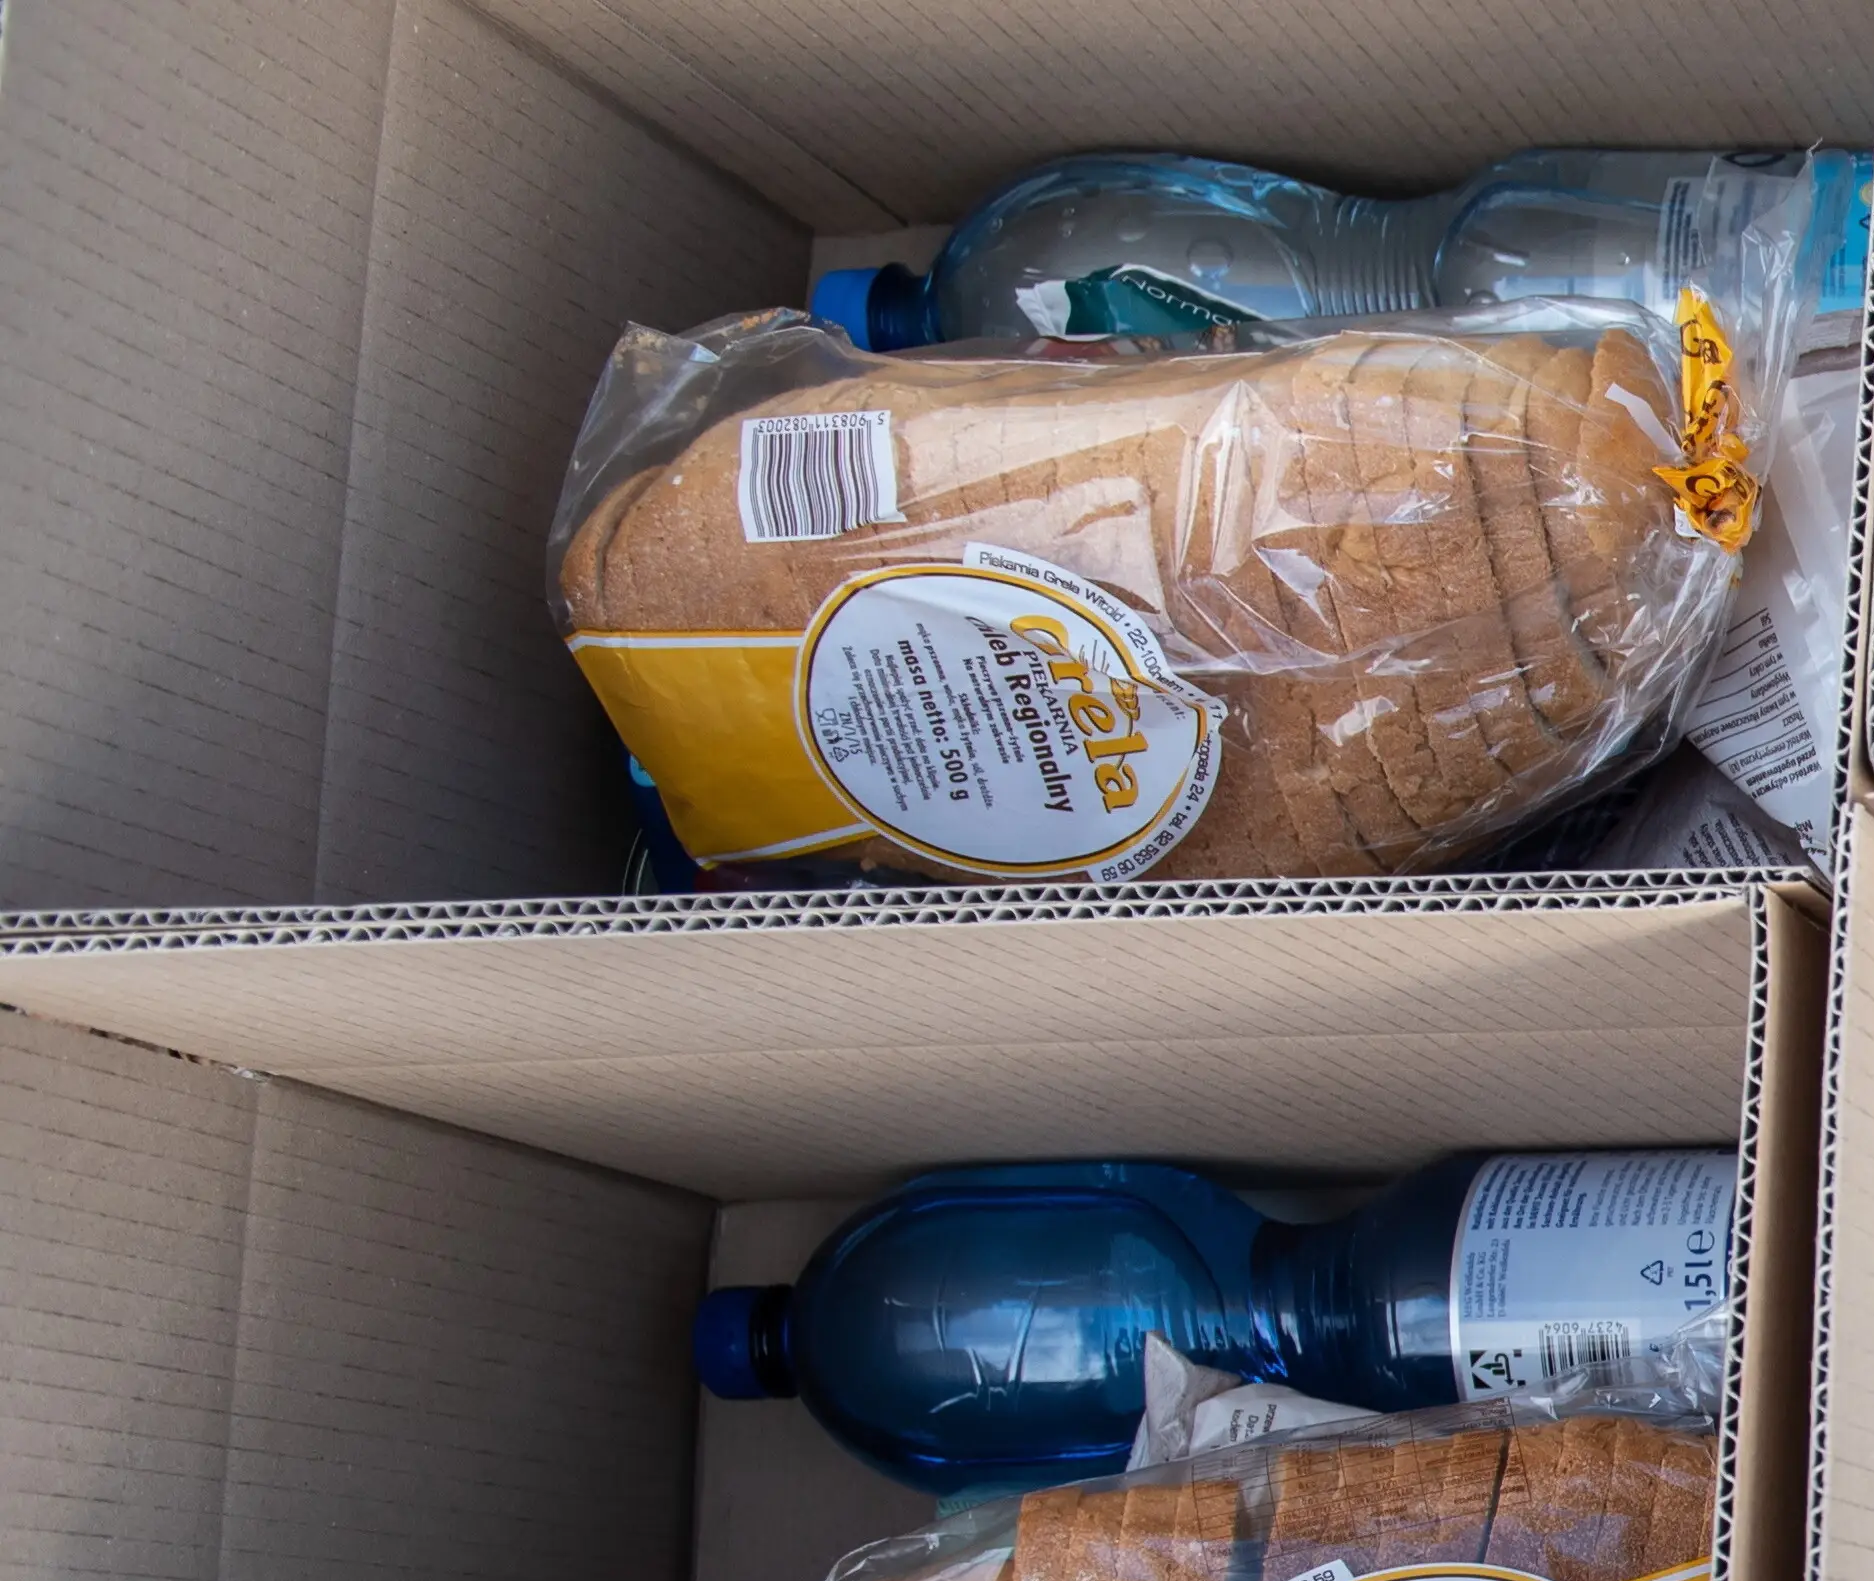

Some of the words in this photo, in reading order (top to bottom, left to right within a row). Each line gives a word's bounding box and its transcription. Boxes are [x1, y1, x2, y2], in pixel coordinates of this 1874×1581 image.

[1120, 272, 1240, 328] Norma
[815, 413, 868, 431] 908311
[1043, 569, 1081, 597] Grela
[1084, 587, 1127, 623] Witold
[898, 639, 923, 690] masa
[917, 688, 950, 744] netto:
[1022, 648, 1079, 758] PIEKARNIA
[940, 748, 968, 787] 500
[1004, 672, 1075, 813] Regionalny
[950, 788, 970, 802] g
